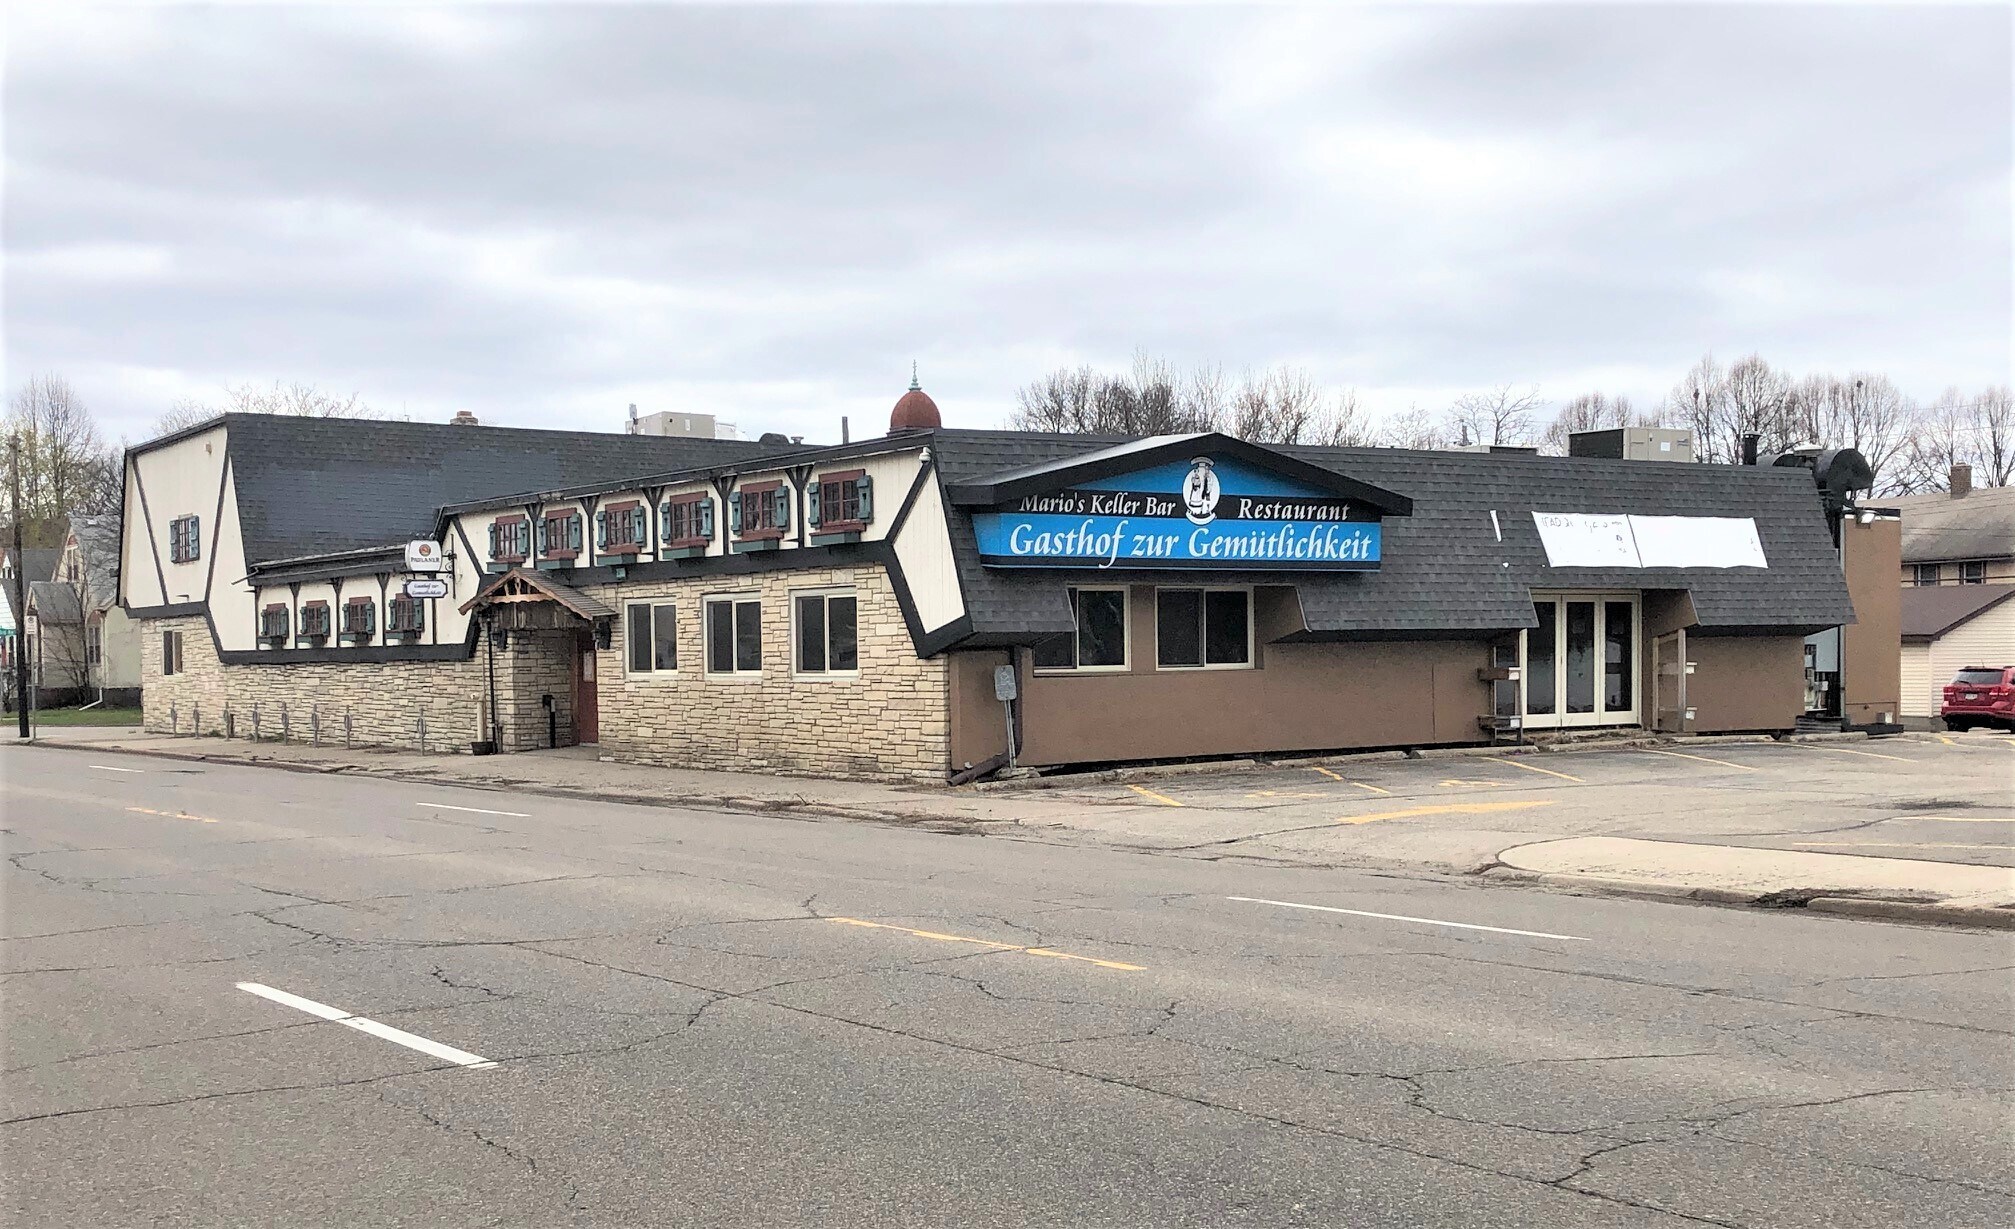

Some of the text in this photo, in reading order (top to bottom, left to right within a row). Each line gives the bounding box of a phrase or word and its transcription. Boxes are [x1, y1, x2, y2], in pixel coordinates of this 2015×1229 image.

[1019, 491, 1176, 516] Mario's Keller Bar
[1237, 498, 1351, 521] Restaurant
[1009, 518, 1372, 569] Gasthof zur Gemütlichkeit
